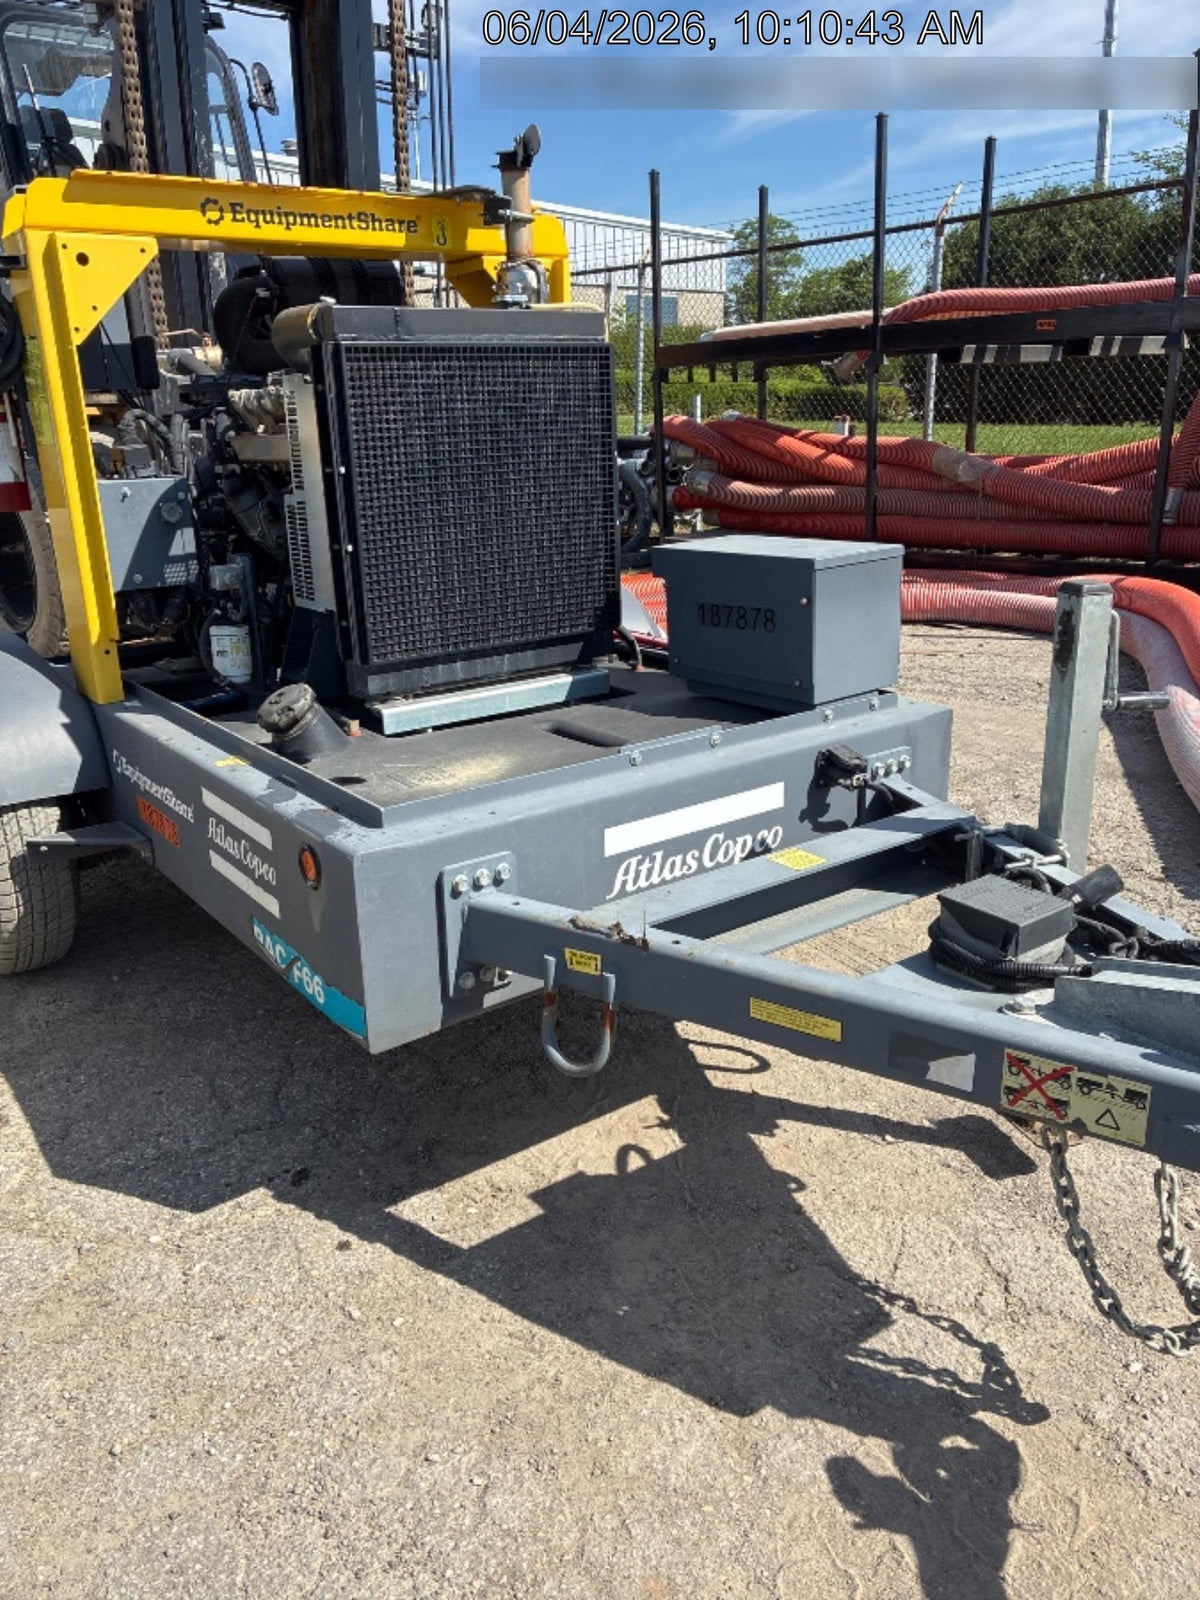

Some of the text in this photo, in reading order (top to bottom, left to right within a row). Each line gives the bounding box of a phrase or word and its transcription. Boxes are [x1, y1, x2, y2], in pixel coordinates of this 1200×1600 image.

[229, 202, 419, 234] EquipmentShare
[698, 602, 776, 633] 187878
[208, 817, 276, 886] Atlas Copco
[606, 848, 700, 900] Atlas
[702, 825, 784, 869] Copco
